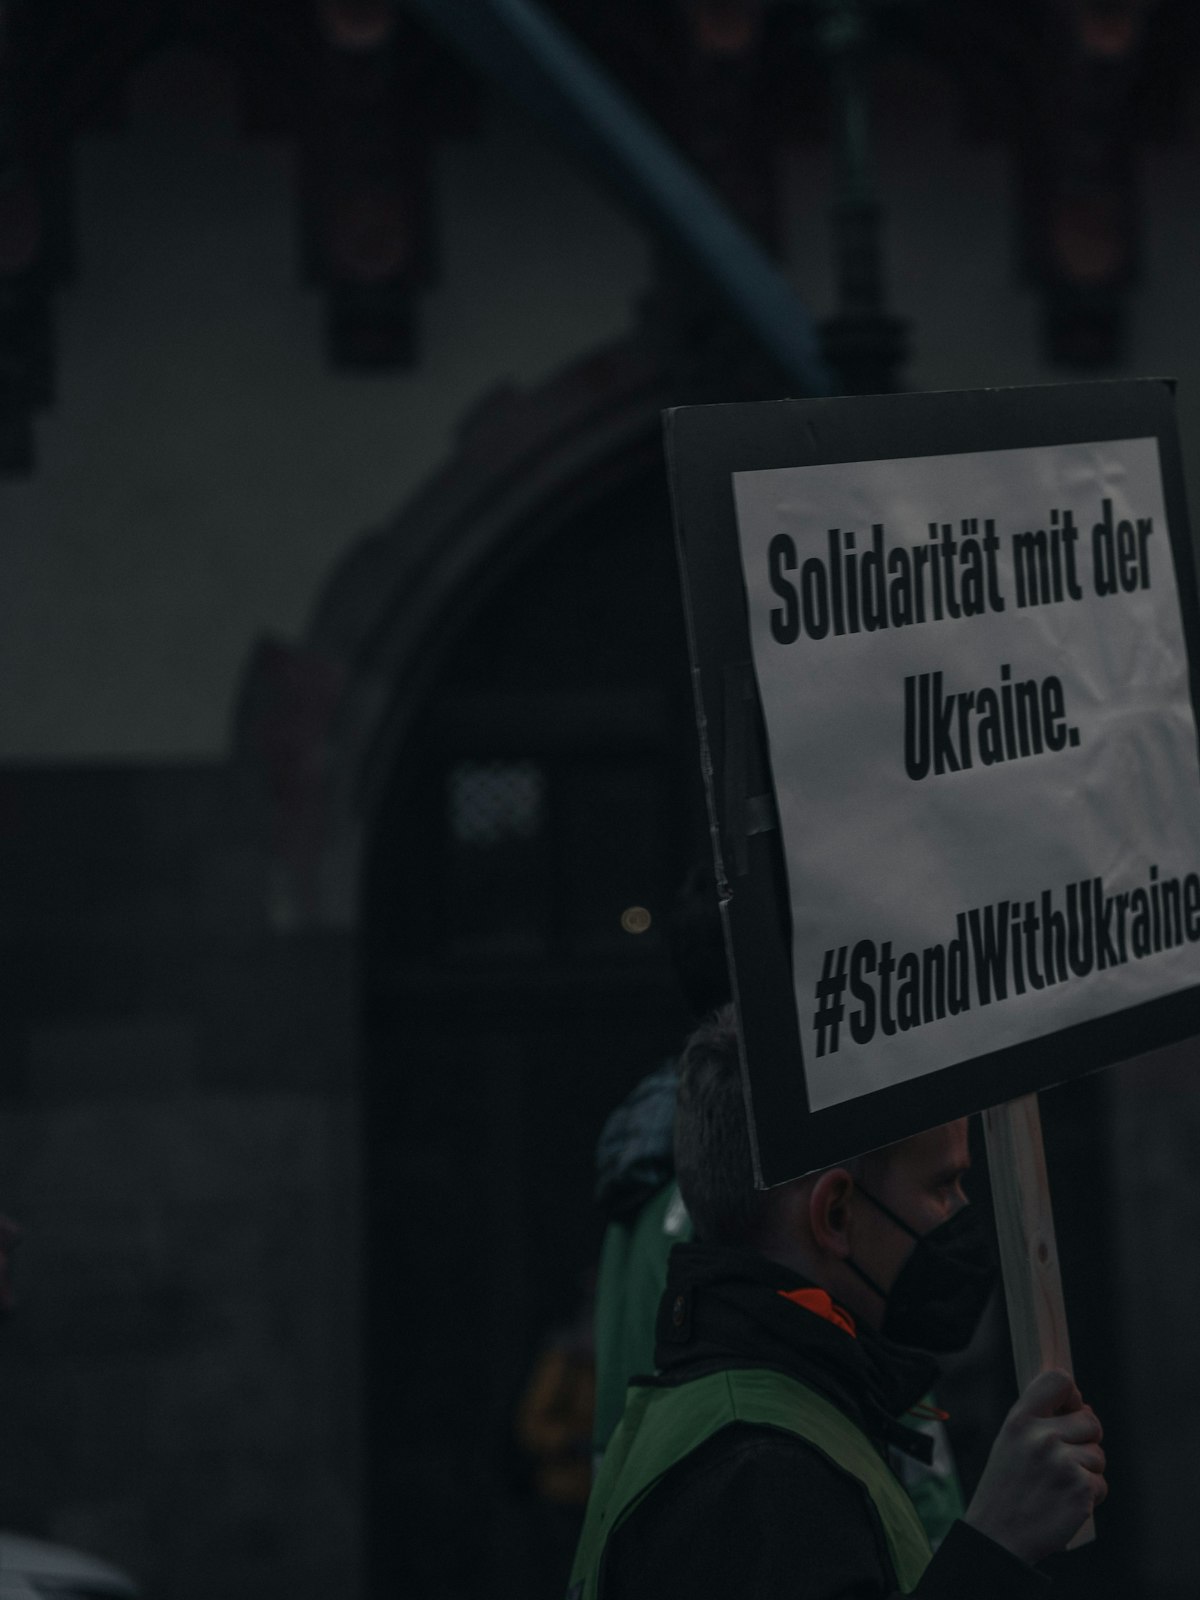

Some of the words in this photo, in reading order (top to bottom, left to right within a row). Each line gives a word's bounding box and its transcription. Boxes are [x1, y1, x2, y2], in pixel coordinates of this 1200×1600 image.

[768, 518, 1004, 645] Solidarität
[1012, 510, 1082, 608] mit
[1092, 499, 1153, 598] der
[905, 664, 1080, 781] Ukraine.
